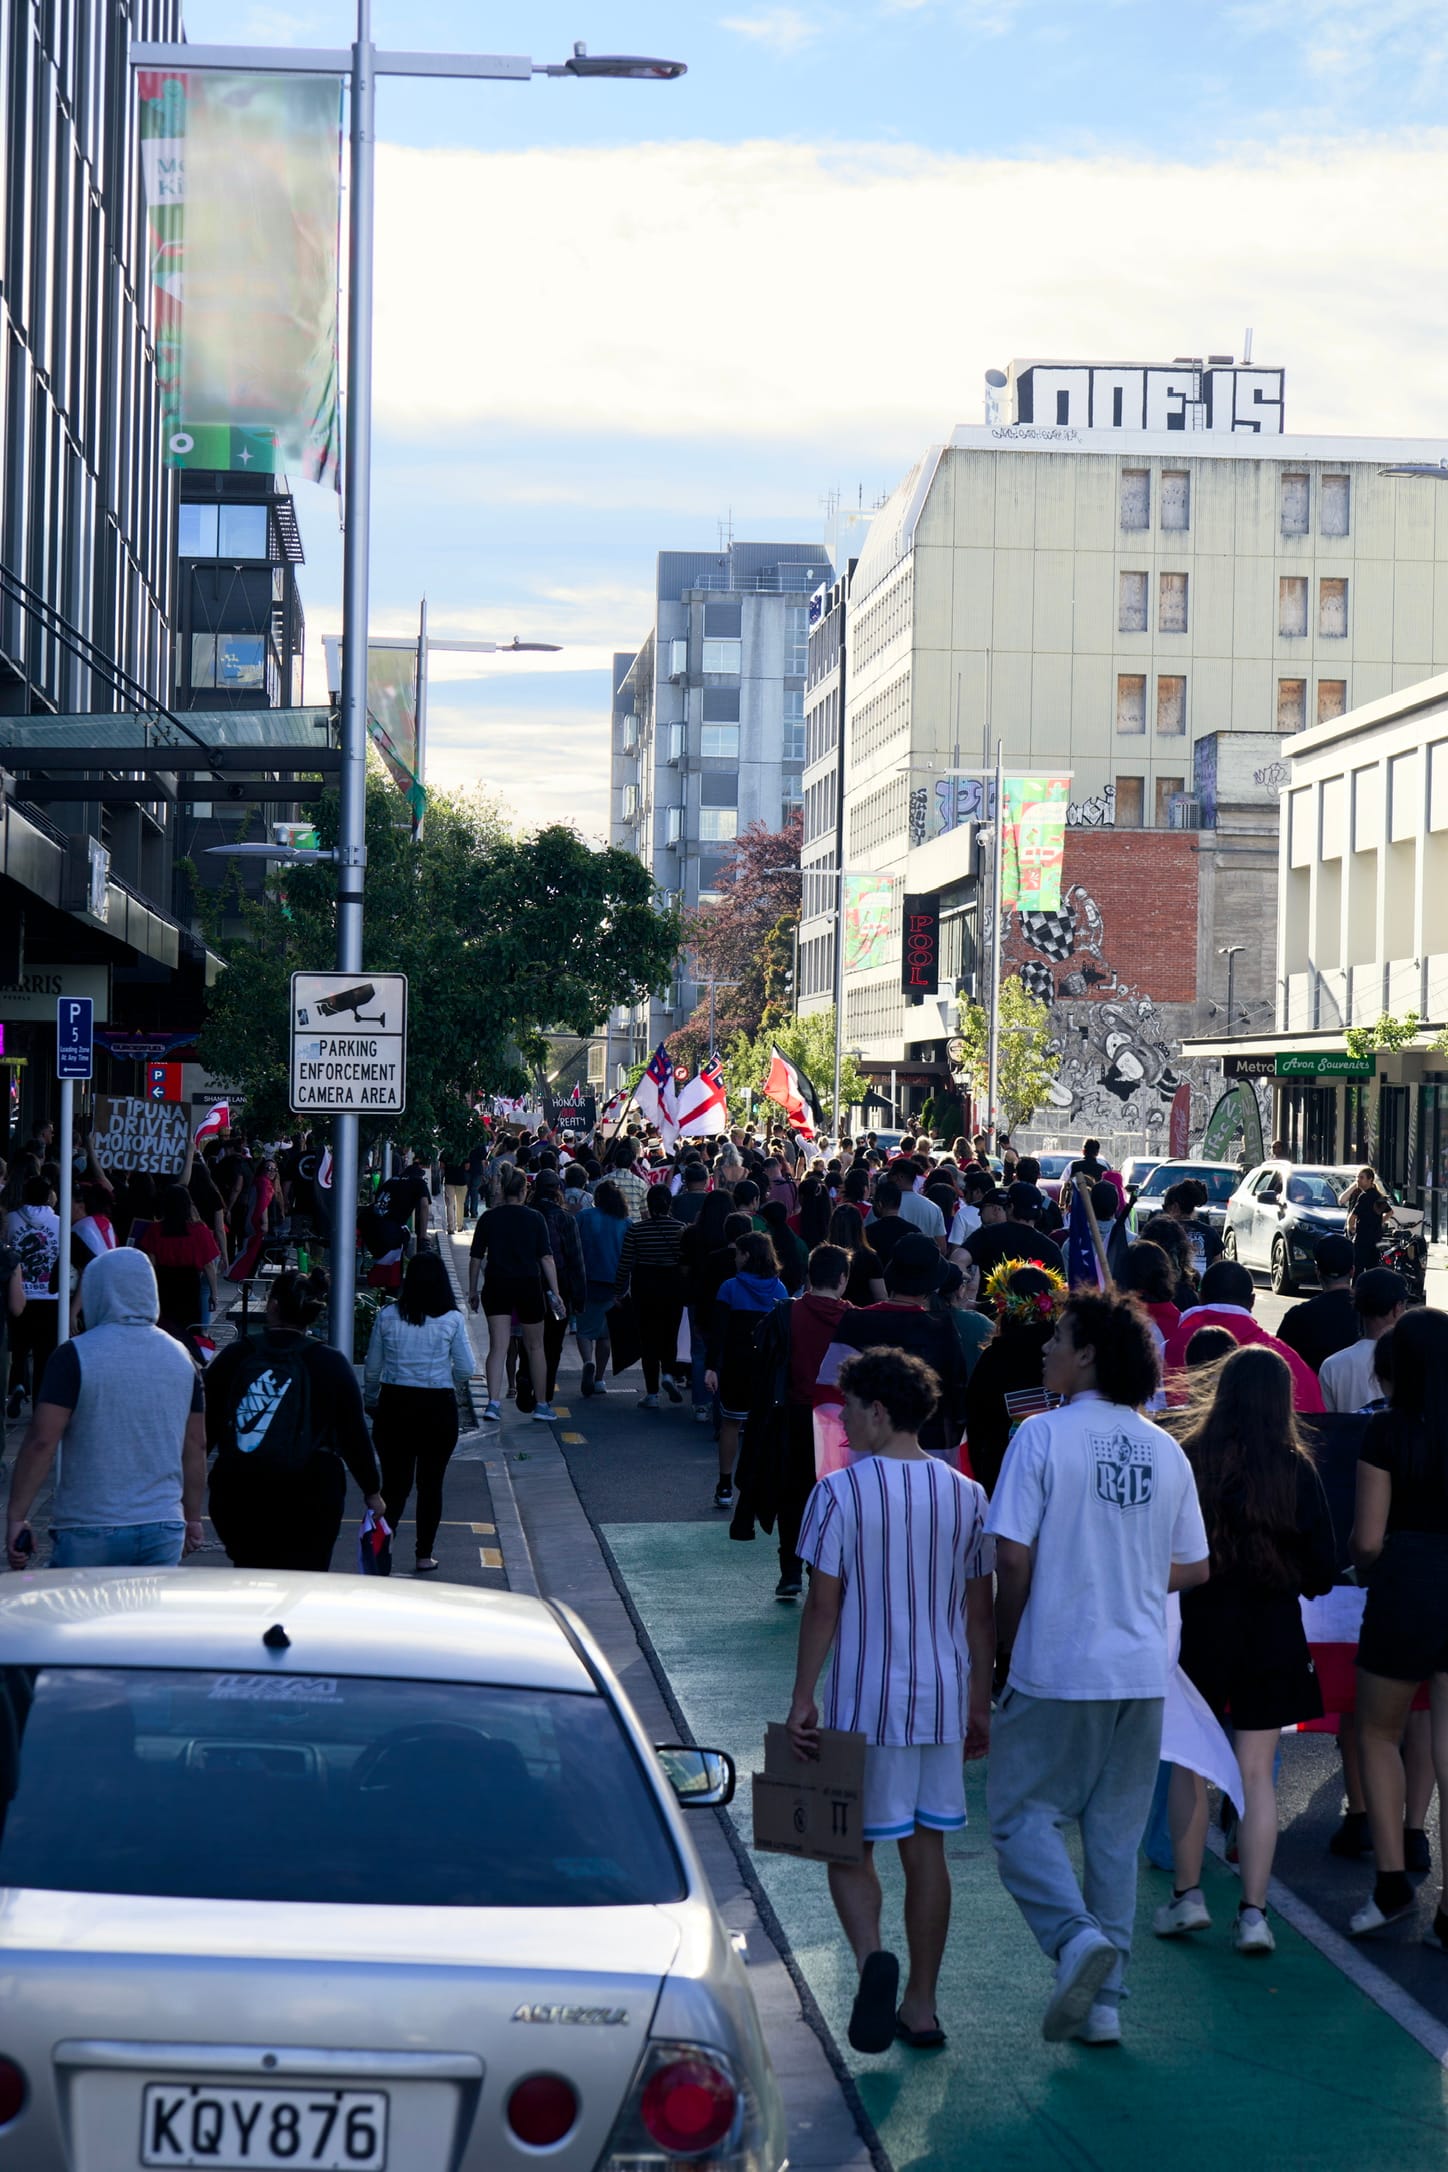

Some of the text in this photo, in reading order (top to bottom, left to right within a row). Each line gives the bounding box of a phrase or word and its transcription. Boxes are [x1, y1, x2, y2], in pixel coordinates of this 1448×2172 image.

[907, 915, 934, 985] POOL
[70, 1003, 81, 1023] P
[72, 1027, 79, 1042] 5
[60, 1046, 78, 1054] Loading
[320, 1040, 377, 1057] PARKING
[68, 1054, 77, 1062] Any
[1236, 1060, 1274, 1073] Metro
[1282, 1057, 1370, 1072] Avon Souvenirs
[300, 1063, 396, 1081] ENFORCEMENT
[298, 1086, 396, 1104] CAMERA AREA
[552, 1098, 586, 1107] HONOUR
[109, 1115, 188, 1138] DRIVEN
[553, 1117, 586, 1127] REATY
[95, 1132, 187, 1157] MOKOPUNA
[96, 1150, 185, 1175] FOCUSSED
[152, 2097, 377, 2160] KQY876
